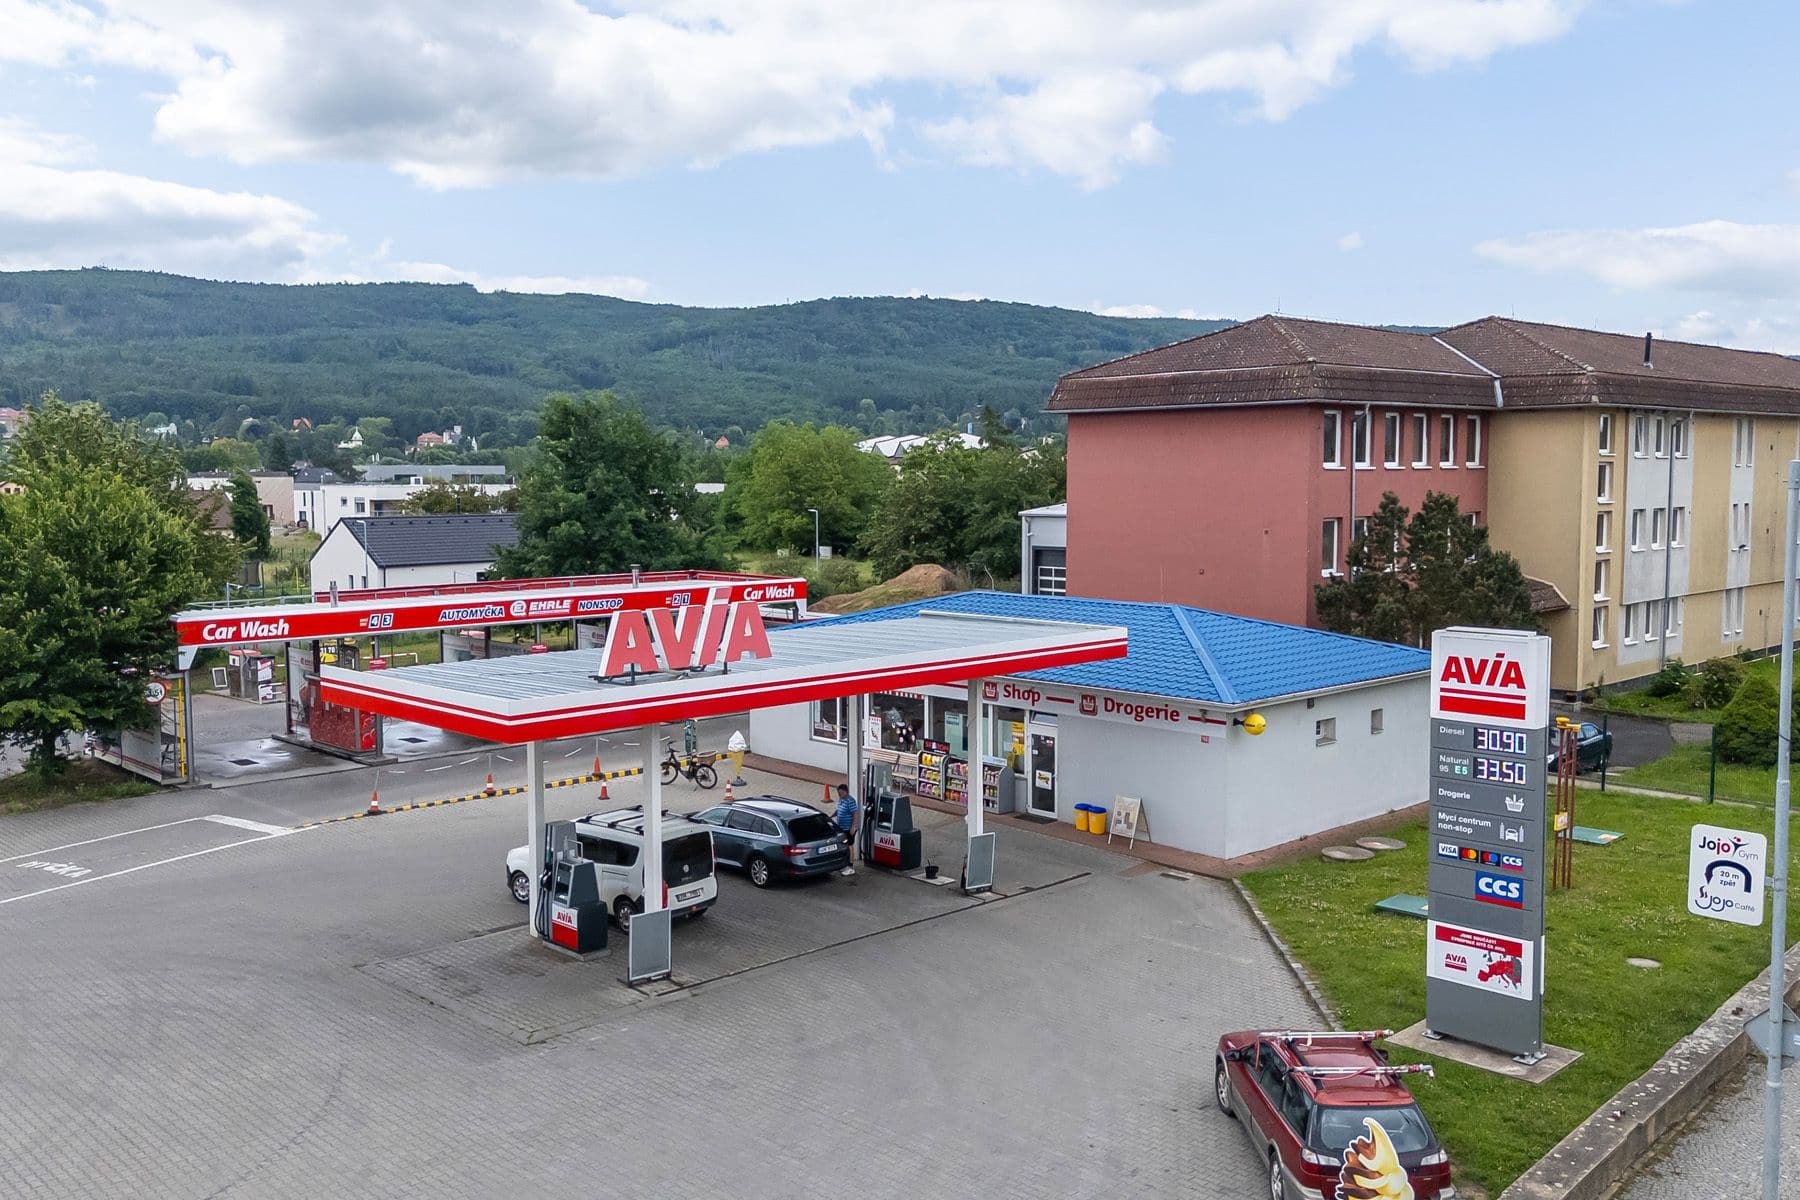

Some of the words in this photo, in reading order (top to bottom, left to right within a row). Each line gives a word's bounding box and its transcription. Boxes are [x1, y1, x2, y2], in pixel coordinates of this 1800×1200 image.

[743, 587, 763, 601] Car
[765, 585, 795, 599] Wash
[529, 600, 572, 611] EHRLE
[578, 599, 623, 610] NONSTOP
[438, 605, 505, 621] AUTOMYČKA
[202, 624, 236, 641] Car
[239, 618, 290, 638] Wash
[1003, 684, 1041, 706] Shop
[1103, 697, 1180, 722] Drogerie
[1439, 726, 1465, 737] Diesel
[1477, 728, 1527, 755] 30.90
[1439, 755, 1470, 766] Natural
[1439, 765, 1449, 773] 95
[1476, 758, 1527, 785] 33.50
[1438, 788, 1471, 800] Drogerie
[1458, 816, 1491, 827] centrum
[1438, 822, 1473, 834] non-stop
[1440, 845, 1457, 855] VISA
[1738, 850, 1759, 861] Gym
[1502, 855, 1522, 866] CCS
[1720, 870, 1730, 878] 20
[1478, 877, 1520, 899] CCS
